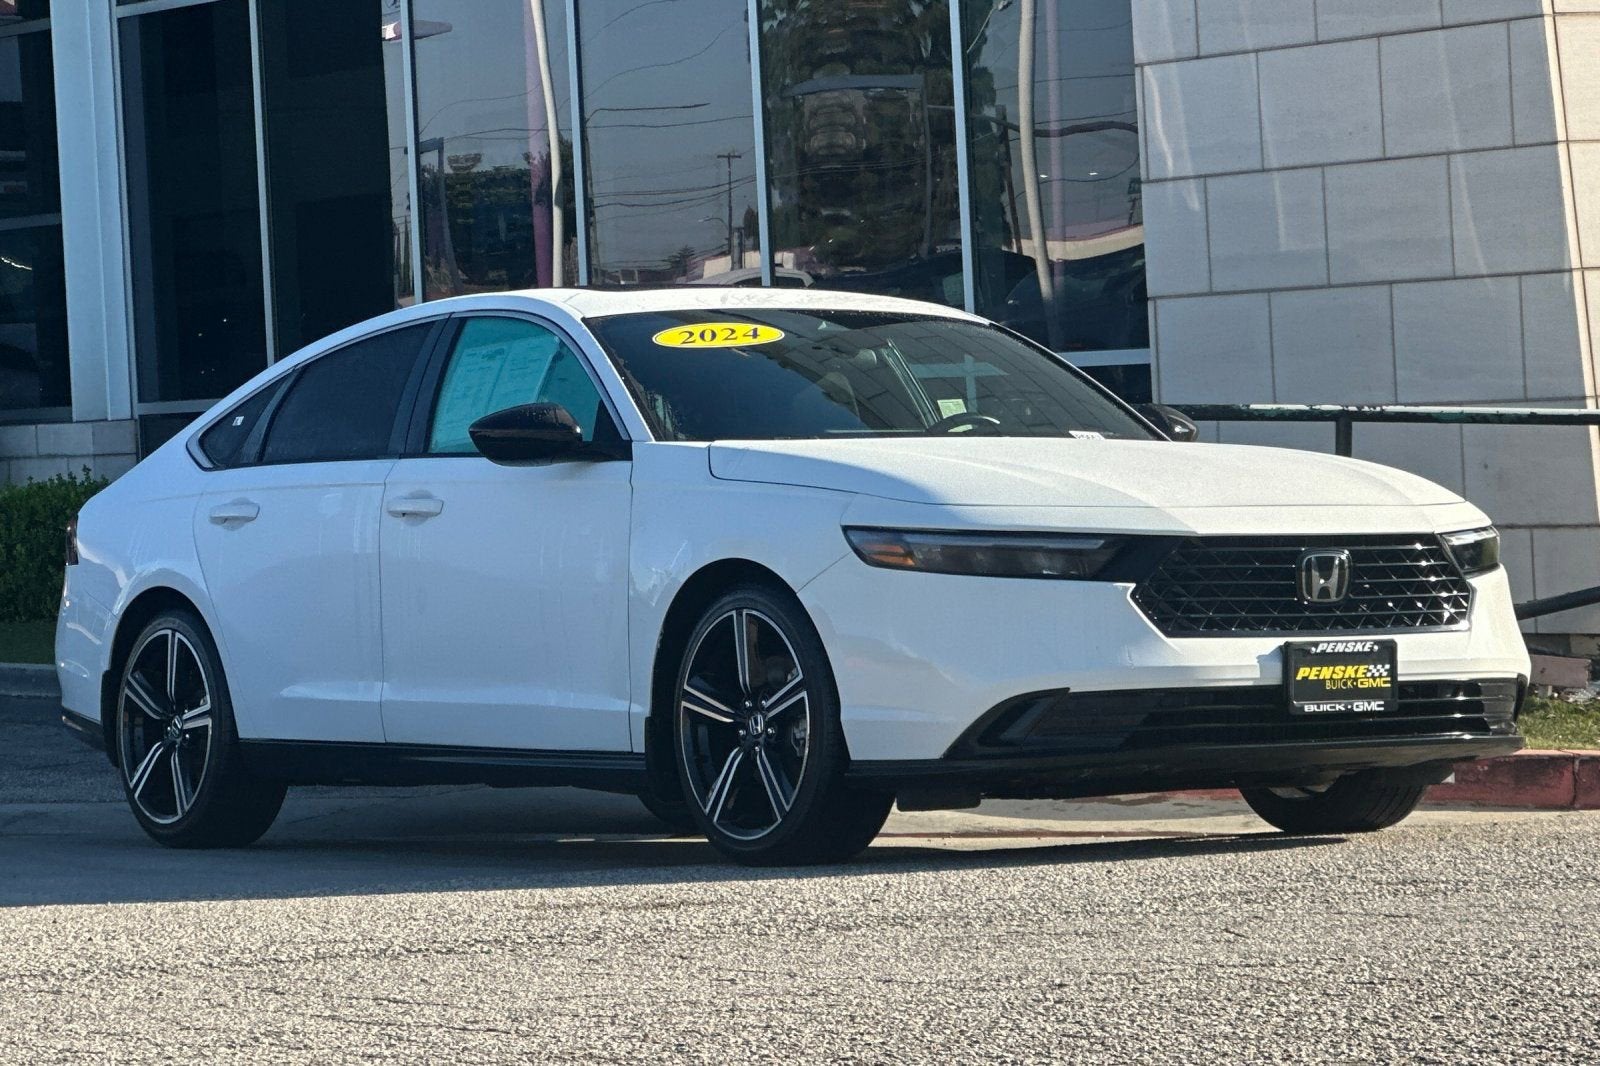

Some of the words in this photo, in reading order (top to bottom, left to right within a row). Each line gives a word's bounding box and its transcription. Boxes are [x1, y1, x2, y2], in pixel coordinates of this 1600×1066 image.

[678, 327, 761, 345] 2024
[1316, 641, 1374, 653] PENSKE
[1296, 665, 1369, 680] PENSKE
[1357, 677, 1391, 688] GMC
[1353, 701, 1384, 712] GMC
